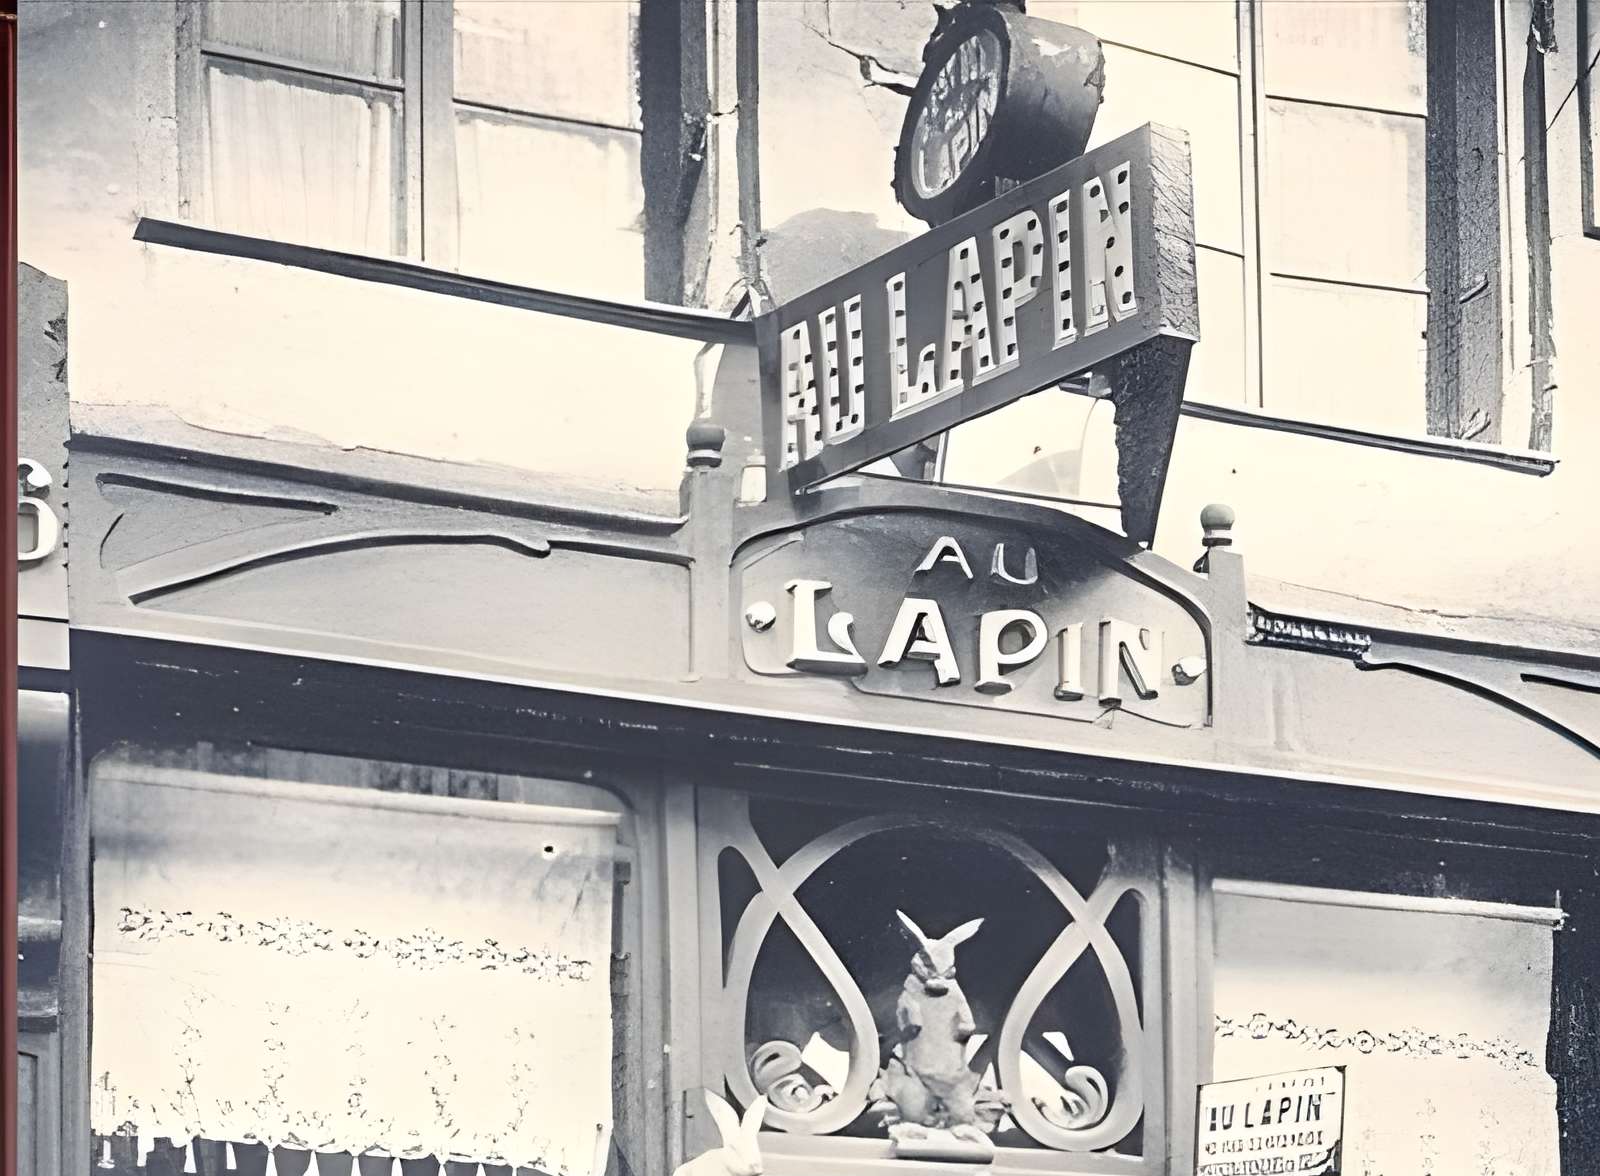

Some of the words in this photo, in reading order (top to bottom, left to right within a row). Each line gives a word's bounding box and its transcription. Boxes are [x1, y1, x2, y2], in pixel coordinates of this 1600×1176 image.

[779, 294, 865, 471] AU
[887, 160, 1138, 421] LAPIN
[914, 535, 1039, 585] AU
[785, 579, 1166, 707] LAPIN
[1244, 1093, 1322, 1128] LAPIN
